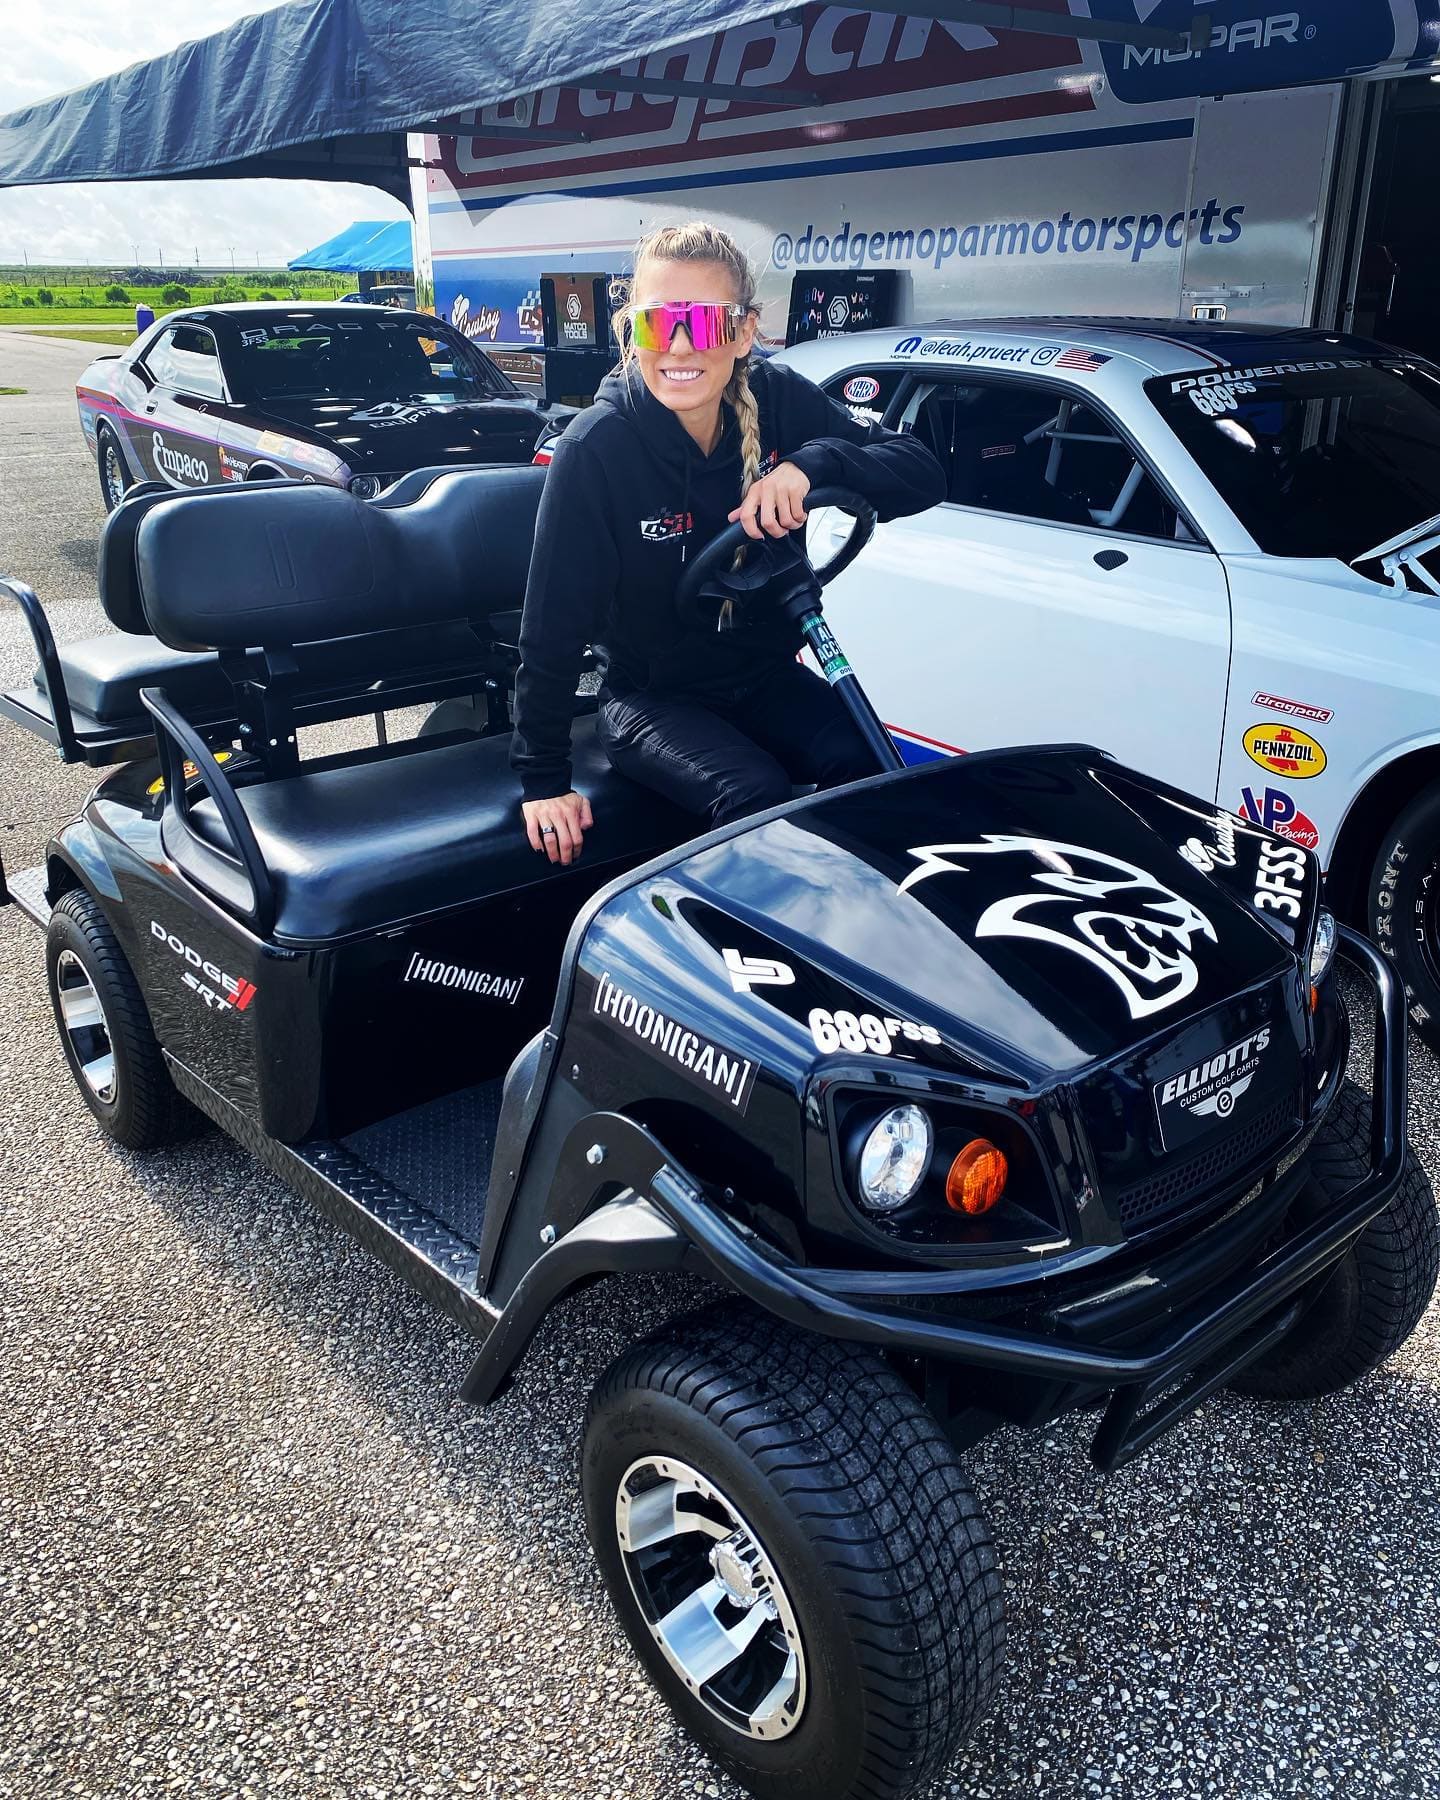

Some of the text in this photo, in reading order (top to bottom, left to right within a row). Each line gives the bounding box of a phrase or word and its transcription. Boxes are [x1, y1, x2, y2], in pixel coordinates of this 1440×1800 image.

[240, 323, 362, 340] DRAG
[564, 322, 587, 331] MATCO
[564, 330, 588, 339] TOOLS
[920, 340, 1030, 362] @leah.pruett
[849, 381, 875, 398] NHRA
[1170, 360, 1337, 393] POWERED
[152, 431, 208, 489] Empaco
[1256, 694, 1329, 721] dragpak
[1253, 739, 1314, 762] PENNZOIL
[1240, 785, 1296, 831] VP
[1277, 825, 1319, 846] Racing
[1253, 840, 1308, 918] 3FSS
[1378, 841, 1408, 957] FRONT
[150, 920, 240, 997] DODGE
[180, 972, 233, 1010] SRT
[1162, 1028, 1271, 1106] ELLIOTT'S
[1180, 1056, 1260, 1108] CUSTOM GOLF CARTS
